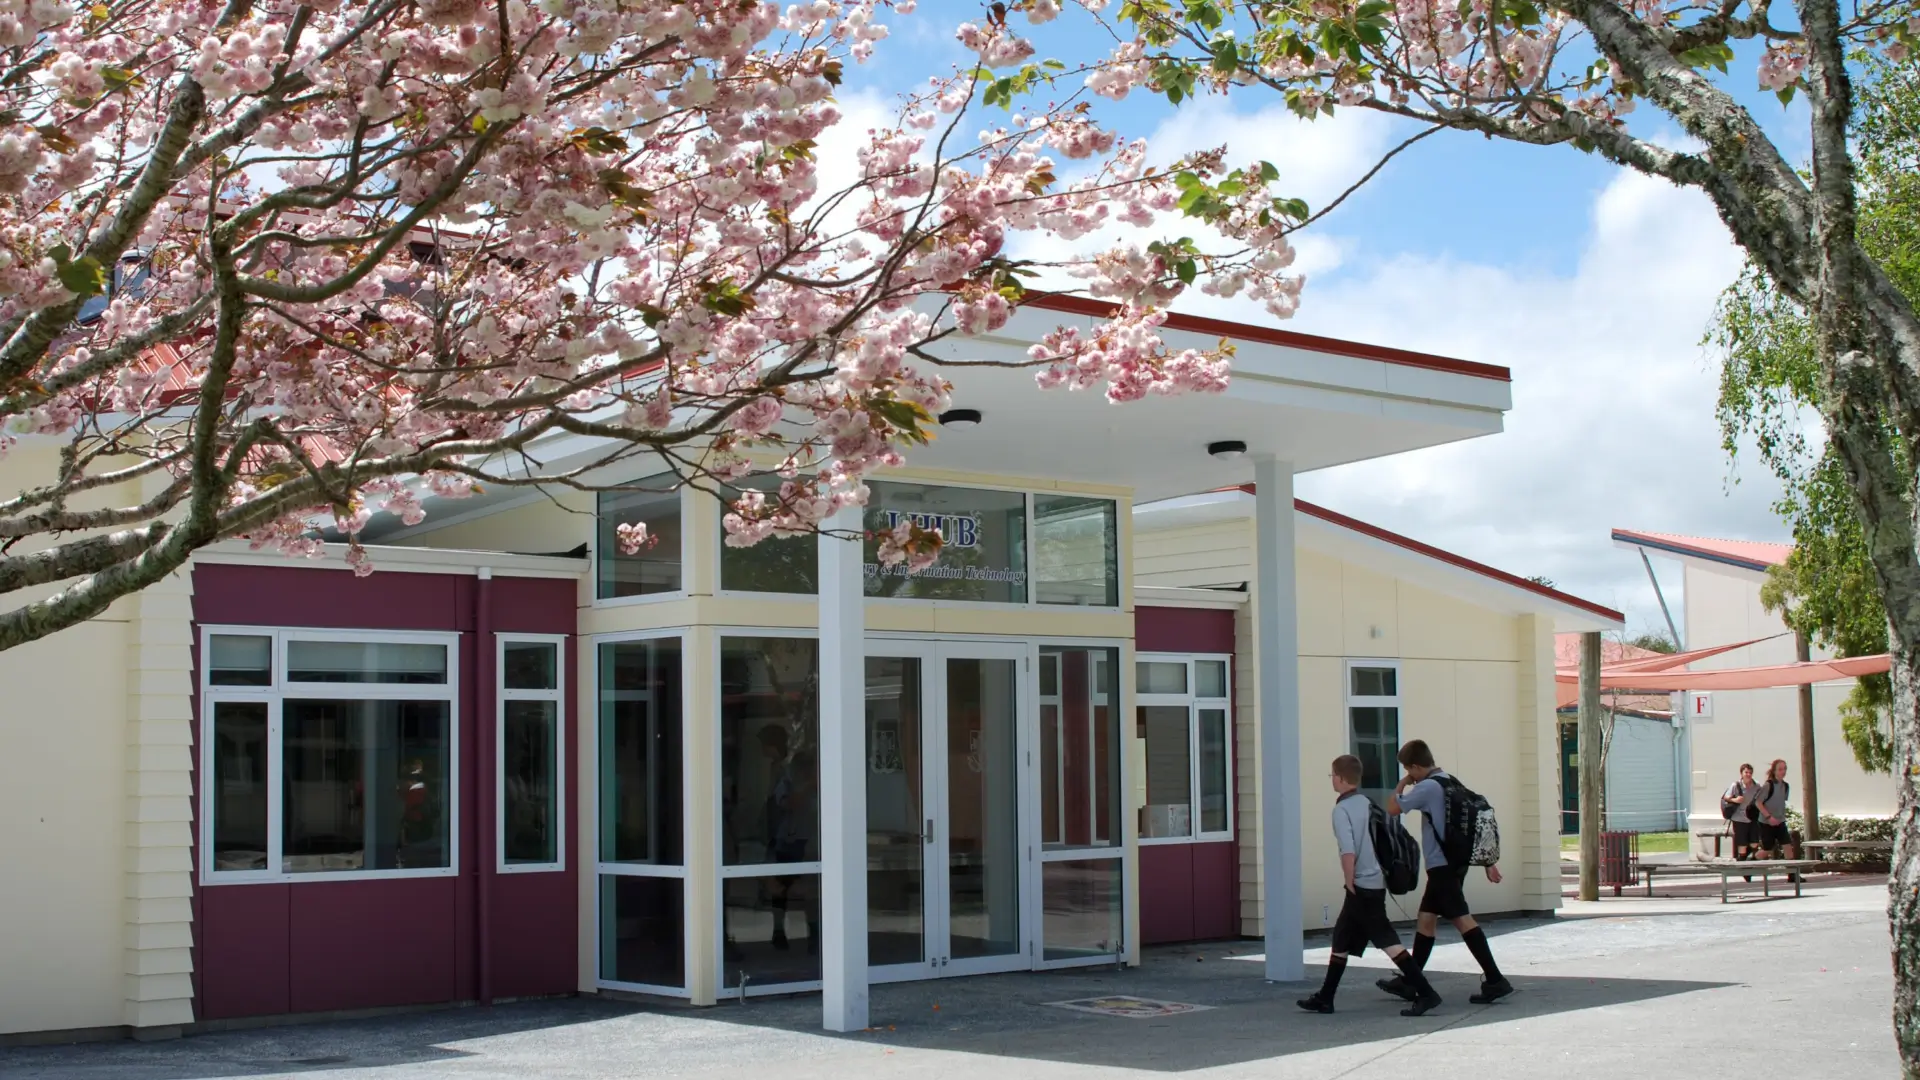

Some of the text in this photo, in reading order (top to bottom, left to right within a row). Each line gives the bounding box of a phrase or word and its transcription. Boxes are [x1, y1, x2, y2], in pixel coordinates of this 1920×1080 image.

[880, 563, 892, 575] &
[893, 562, 963, 580] Infrmation
[965, 565, 1026, 585] Technology
[1696, 696, 1708, 714] F
